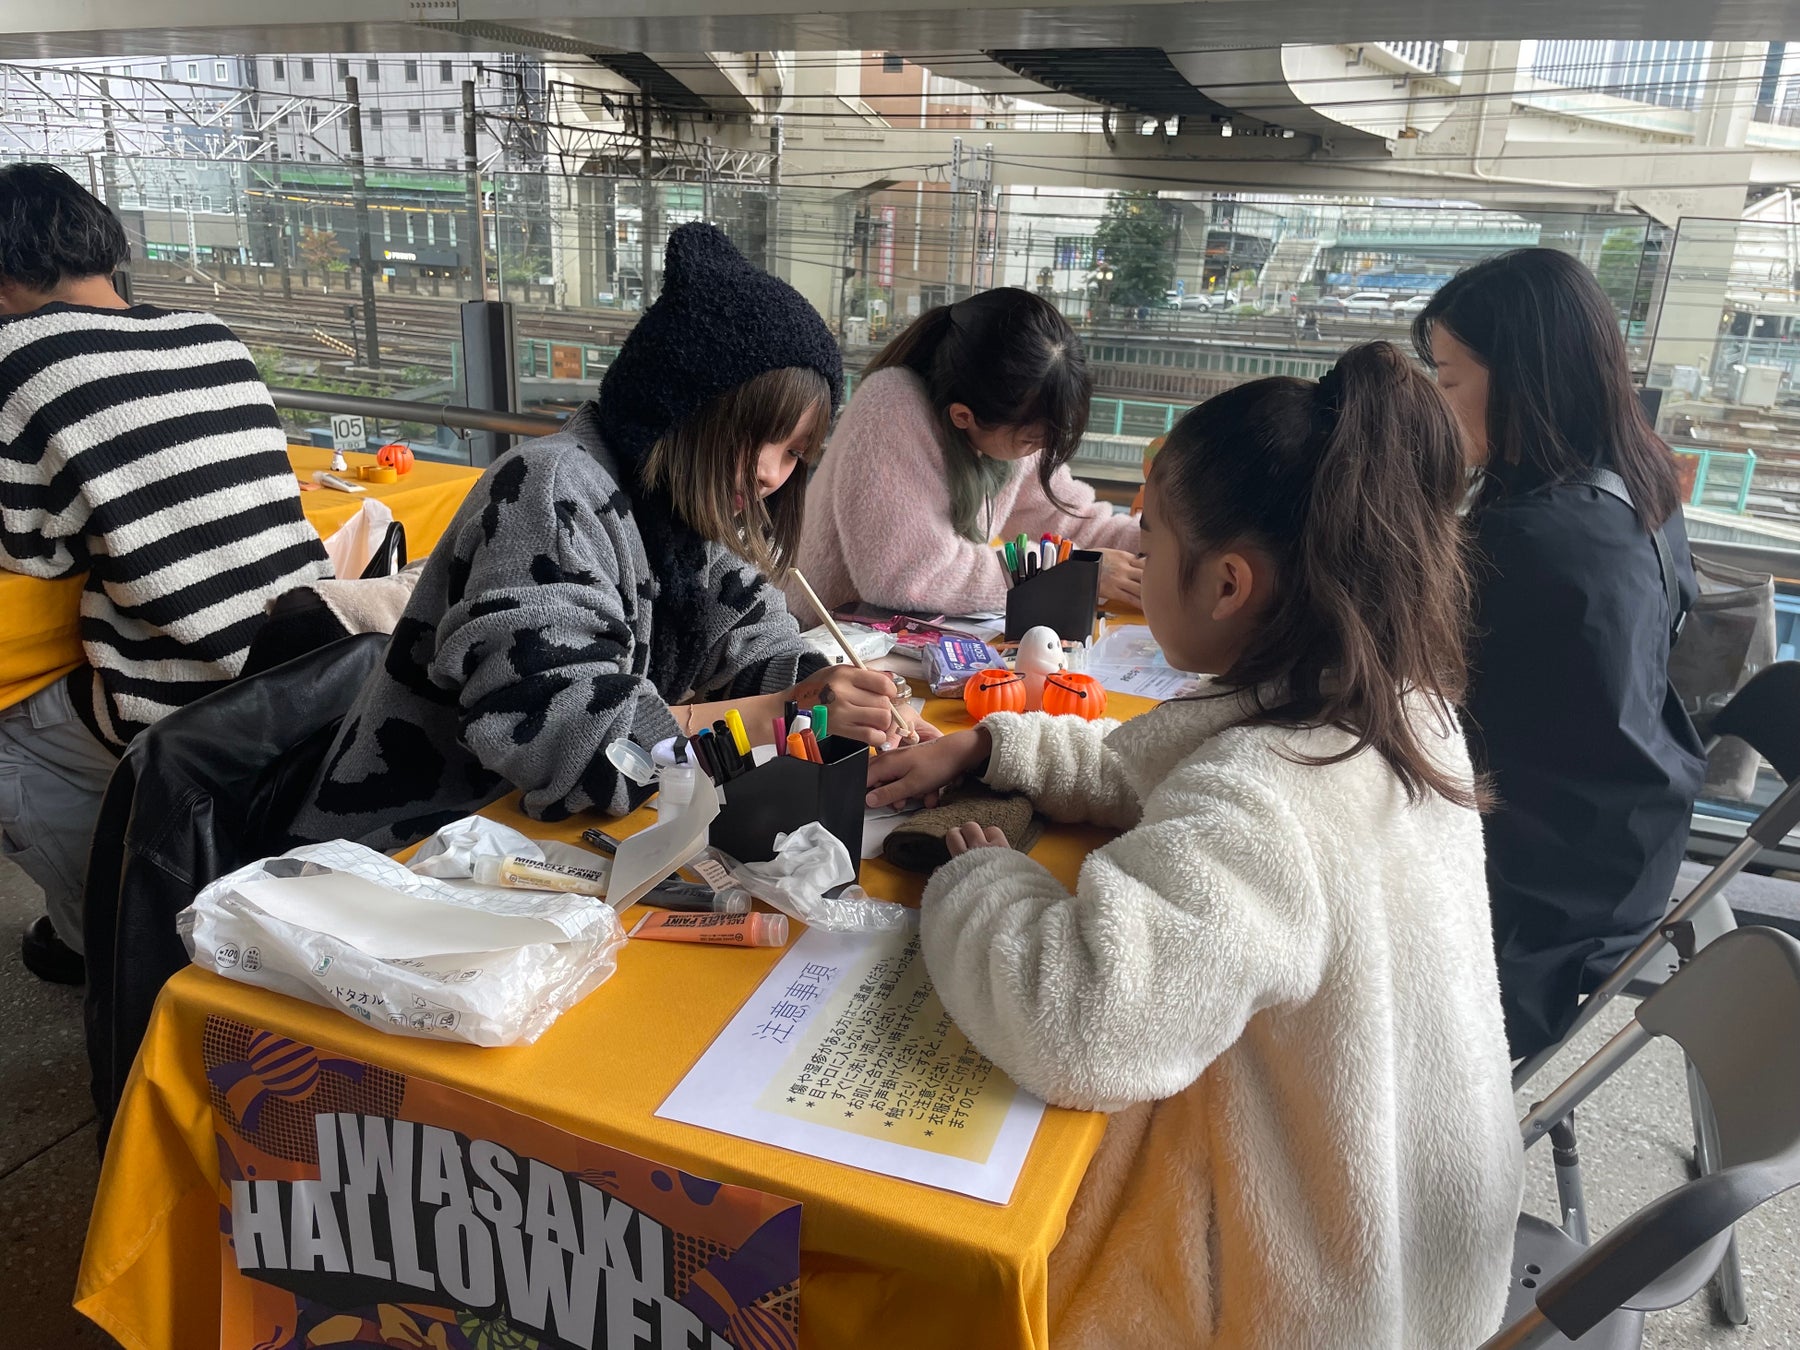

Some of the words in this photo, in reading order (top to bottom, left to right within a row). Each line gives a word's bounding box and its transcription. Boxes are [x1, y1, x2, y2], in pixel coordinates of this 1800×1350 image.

[334, 418, 362, 440] 105
[514, 856, 567, 872] MIRACLE
[566, 868, 602, 880] PAINT
[663, 917, 698, 927] PAINT
[725, 917, 746, 926] FACE
[329, 986, 384, 1006] ドタオル
[751, 961, 838, 1045] 注意事項
[315, 1112, 665, 1295] IWASAKI
[231, 1179, 736, 1350] HALLOWE
